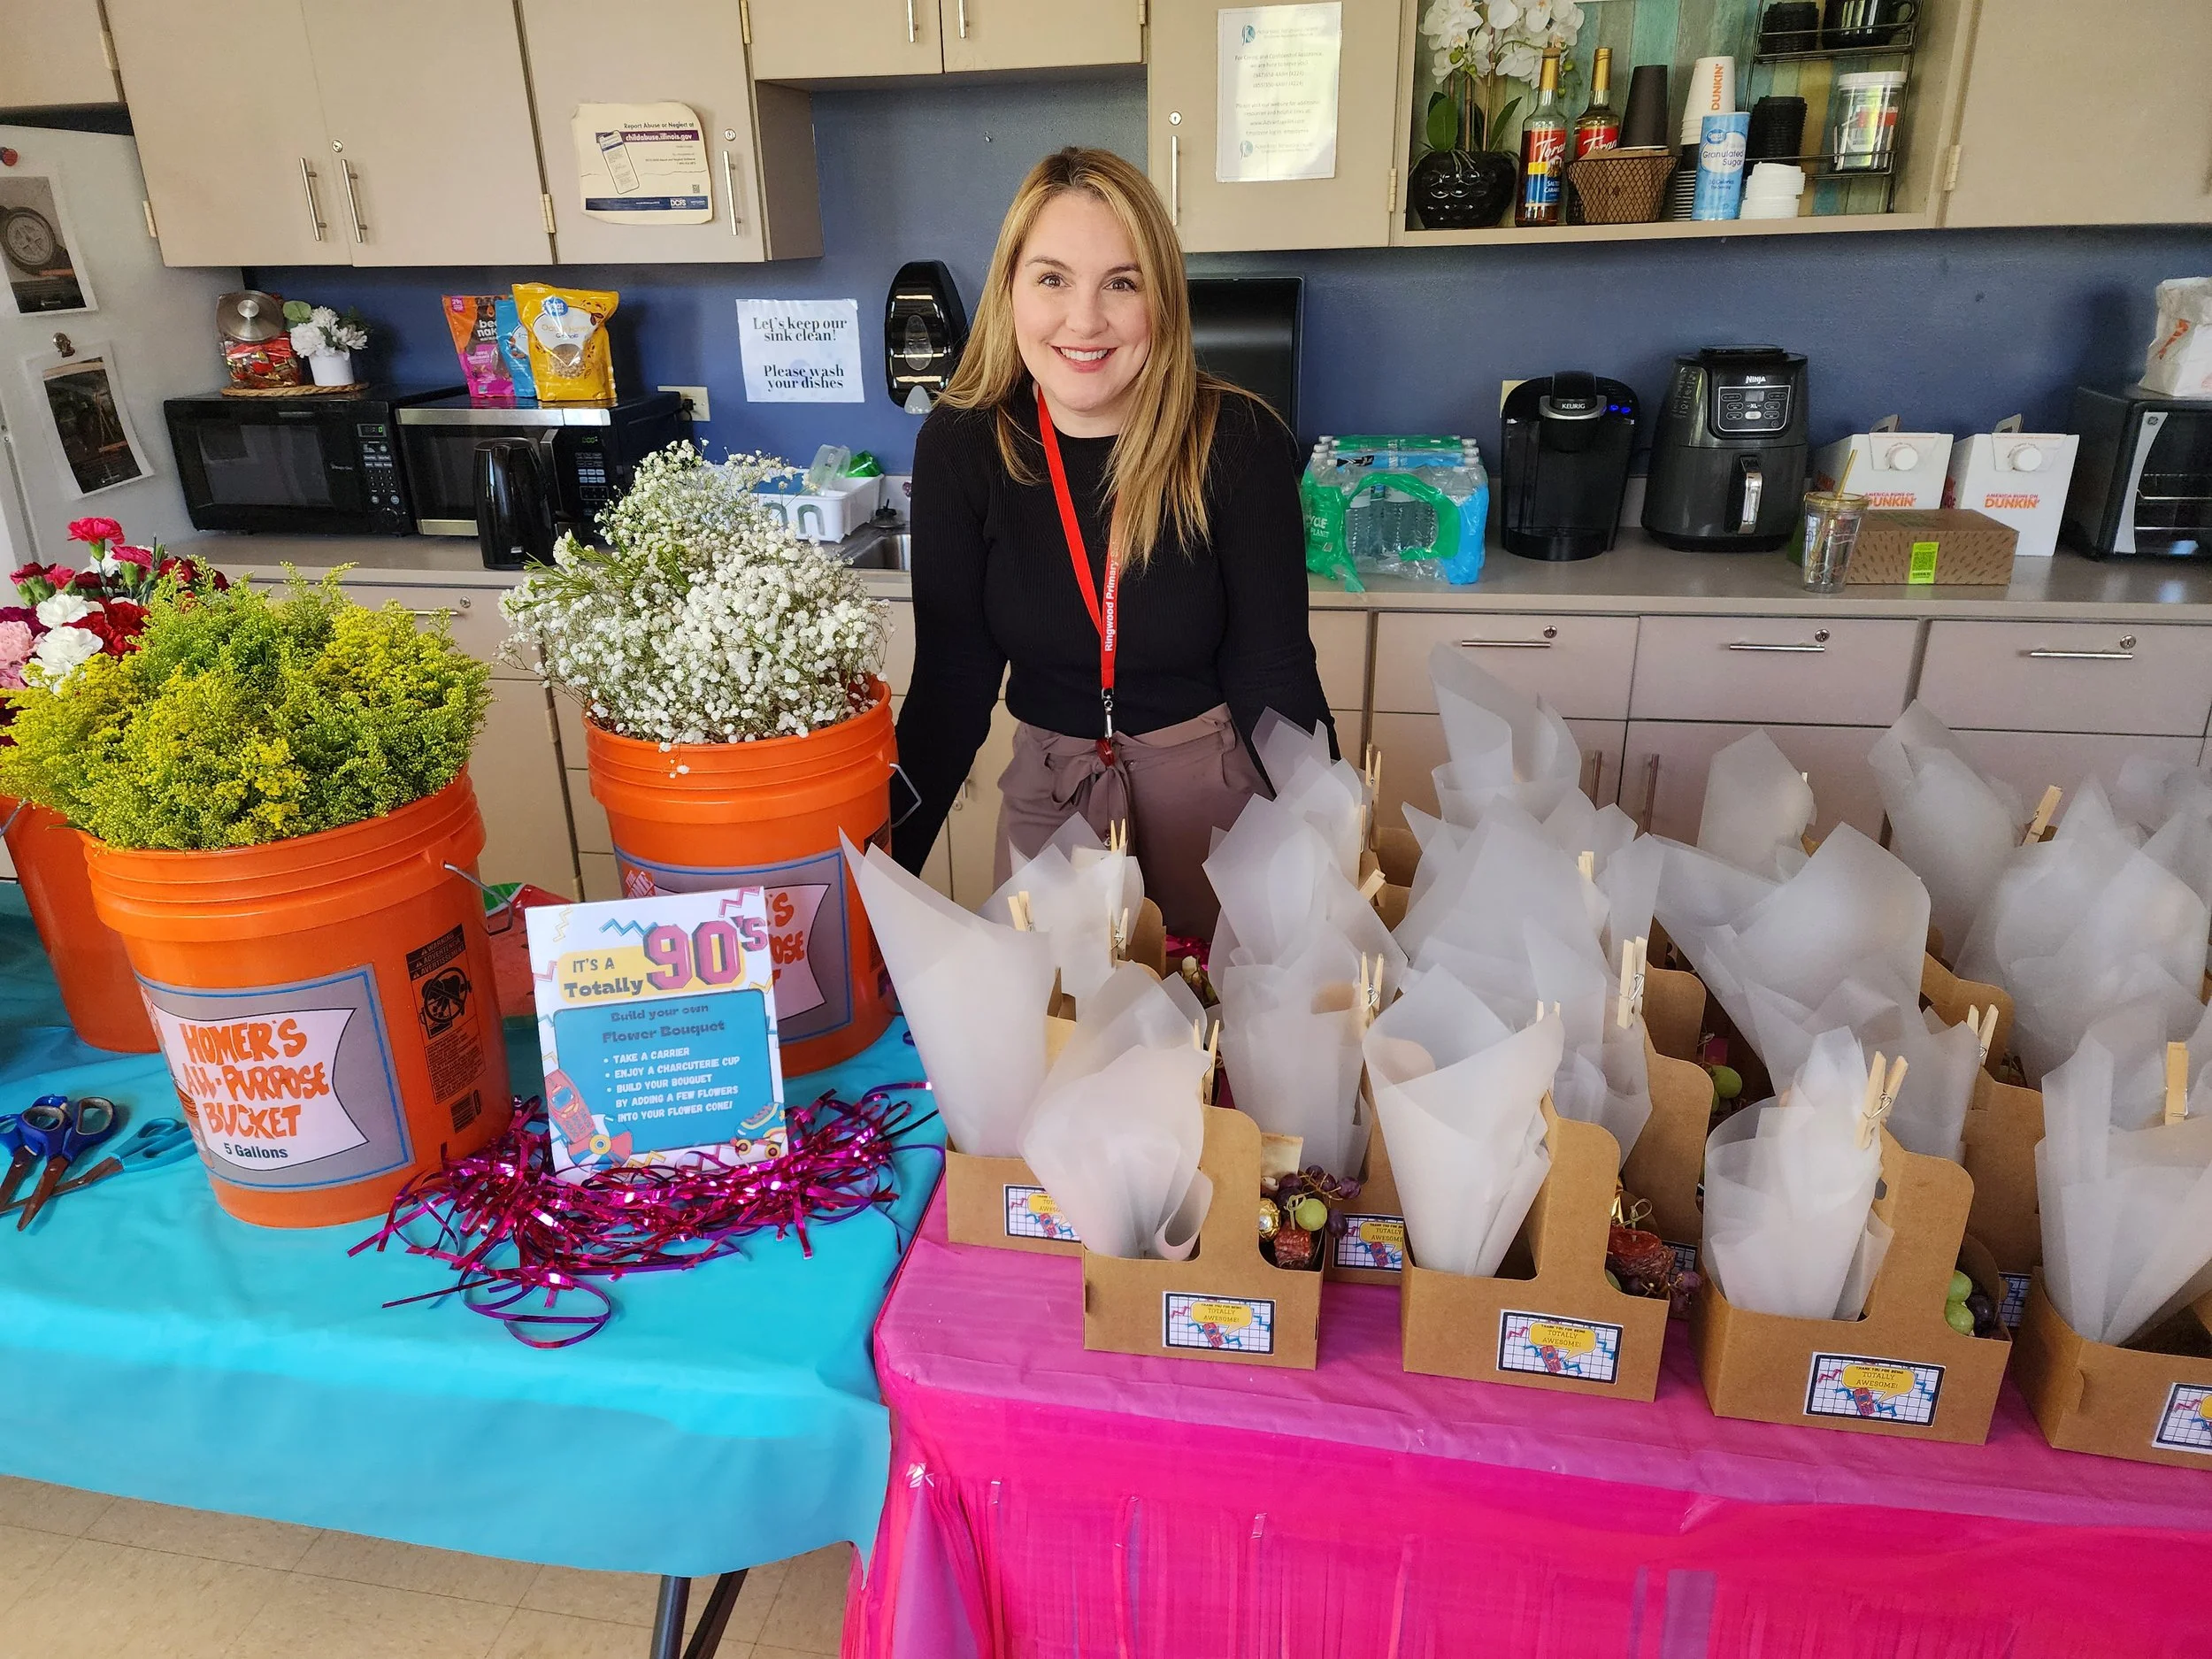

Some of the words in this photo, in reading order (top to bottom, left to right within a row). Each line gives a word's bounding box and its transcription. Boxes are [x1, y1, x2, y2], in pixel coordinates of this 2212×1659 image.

[1711, 63, 1724, 111] DUNKIN'
[625, 132, 693, 142] childabuse.illinois.gov
[1702, 150, 1745, 158] Granulated
[1722, 158, 1743, 168] Sugar
[753, 317, 785, 330] Let's
[787, 317, 820, 333] keep
[823, 319, 848, 330] our
[764, 329, 793, 342] sink
[795, 328, 837, 342] clean!
[764, 365, 806, 377] Please
[809, 364, 844, 377] wash
[767, 379, 799, 392] your
[801, 376, 844, 389] dishes
[1745, 375, 1767, 384] NINJA
[1985, 497, 2040, 508] DUNKIN'
[1106, 559, 1118, 600] Primary
[1104, 602, 1117, 651] Ringwood
[572, 956, 598, 973] IT'S
[604, 956, 615, 971] A
[564, 977, 643, 998] Totally
[611, 1010, 646, 1023] Build
[648, 1007, 679, 1020] your
[681, 1004, 709, 1015] own
[603, 1026, 657, 1043] Flower
[660, 1019, 726, 1037] Bouquet
[180, 1018, 308, 1065] HOMER'S
[613, 1053, 638, 1064] TAKE
[641, 1051, 648, 1061] A
[650, 1047, 690, 1060] CARRIER
[614, 1067, 644, 1079] ENJOY
[648, 1066, 655, 1075] A
[657, 1058, 720, 1074] CHARCUTERIE
[722, 1056, 741, 1066] CUP
[616, 1082, 641, 1094] BUILD
[644, 1079, 669, 1090] YOUR
[672, 1073, 712, 1087] BOUQUET
[616, 1099, 628, 1108] BY
[631, 1094, 664, 1106] ADDING
[666, 1093, 674, 1102] A
[676, 1090, 695, 1101] FEW
[697, 1085, 739, 1098] FLOWERS
[618, 1111, 638, 1123] INTO
[641, 1109, 665, 1120] YOUR
[667, 1103, 703, 1117] FLOWER
[705, 1100, 733, 1112] CONE!
[202, 1104, 302, 1141] BUCKET
[223, 1142, 234, 1156] 5
[234, 1142, 288, 1159] Gallons
[1542, 1337, 1582, 1348] AWESOME!
[1548, 1330, 1578, 1340] TOTALLY
[1855, 1379, 1899, 1389] AWESOME!
[1863, 1371, 1895, 1380] TOTALLY
